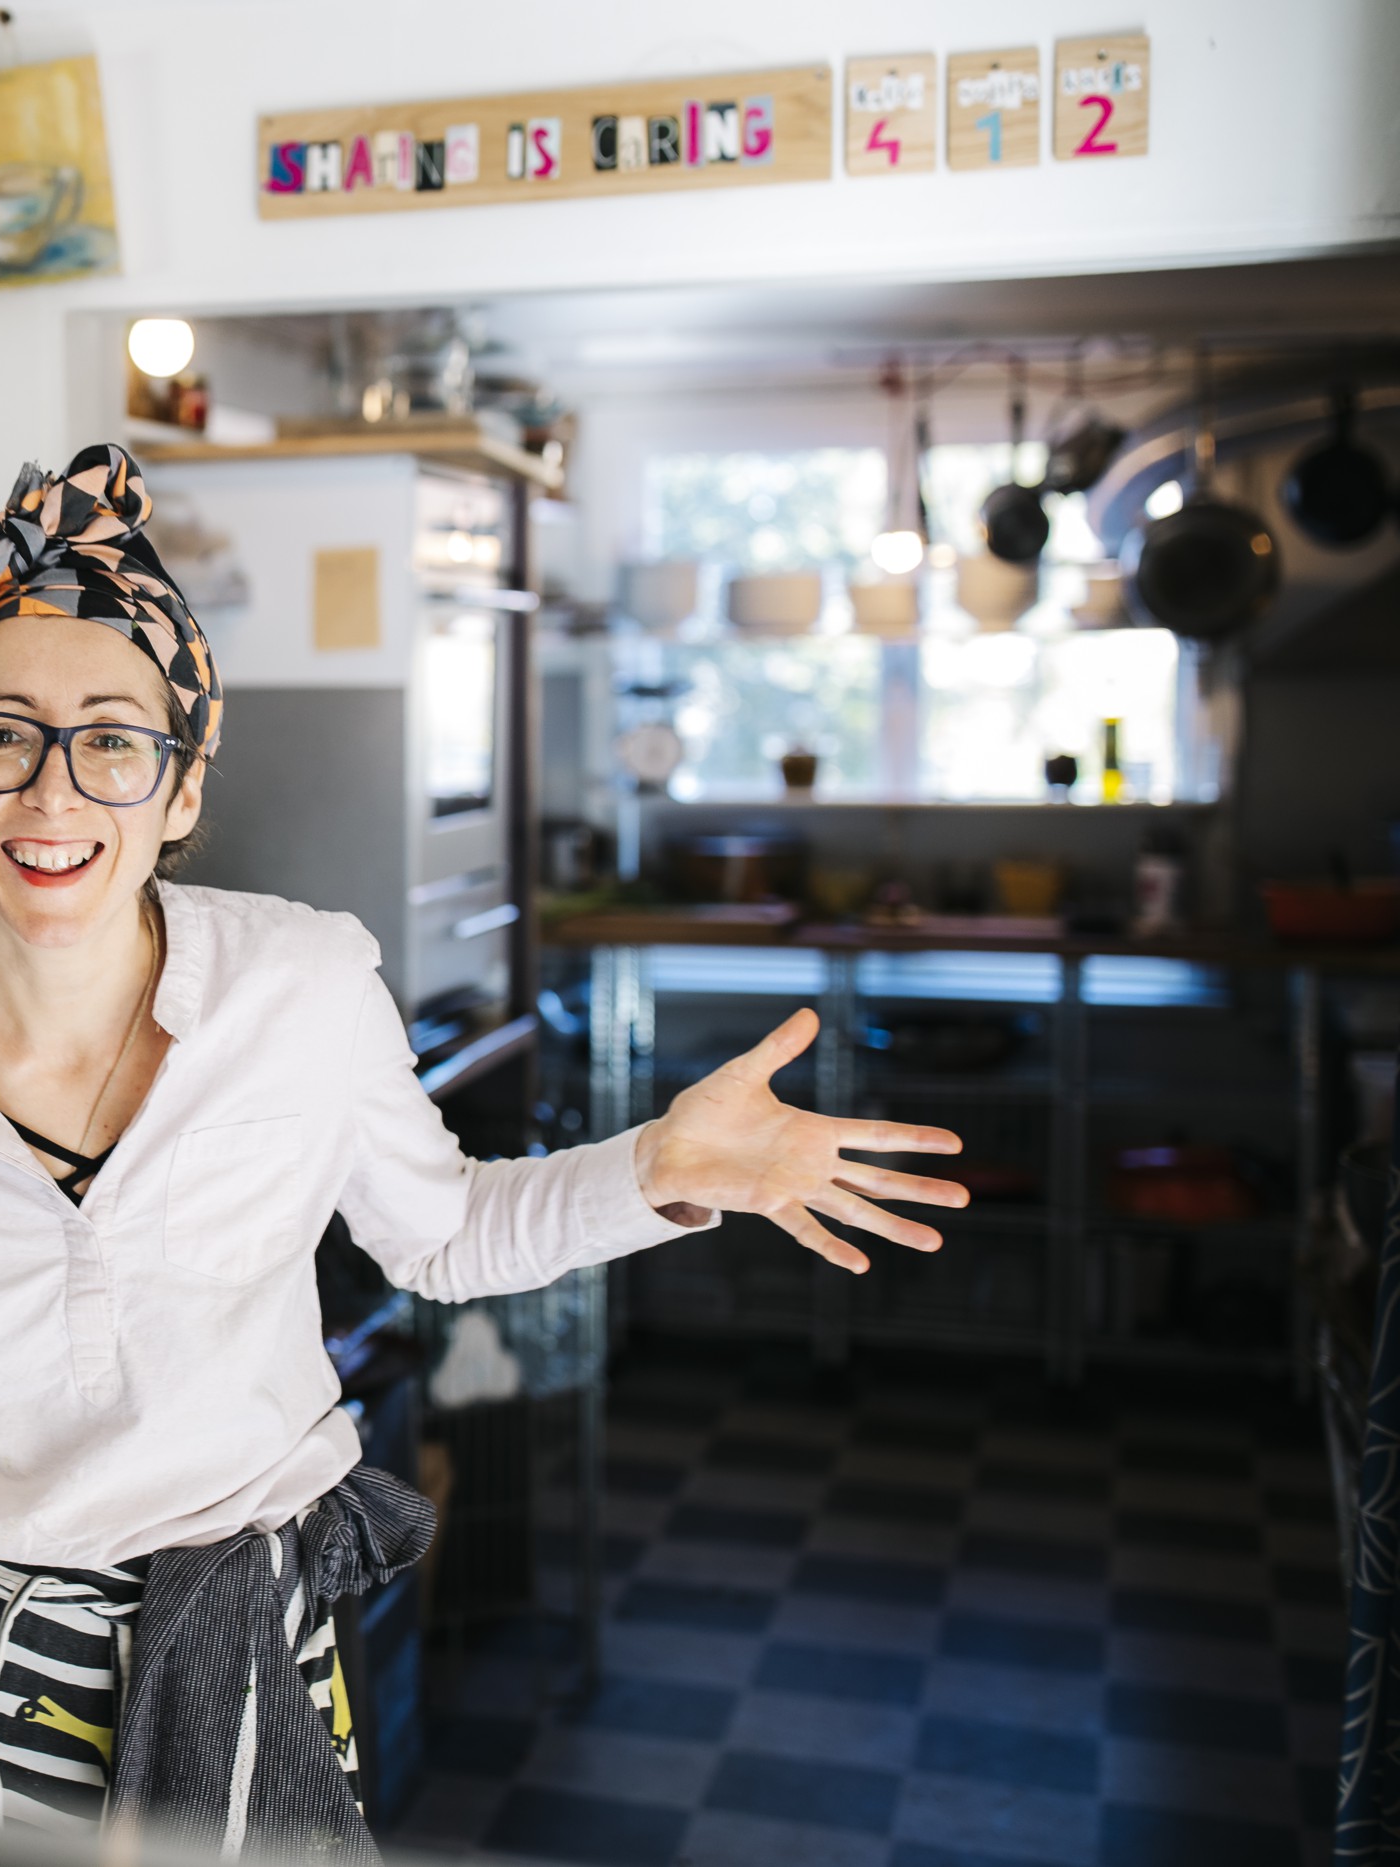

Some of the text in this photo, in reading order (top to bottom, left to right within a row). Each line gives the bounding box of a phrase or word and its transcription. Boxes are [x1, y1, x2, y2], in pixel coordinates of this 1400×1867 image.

[508, 124, 558, 180] IS
[865, 117, 902, 166] 4
[975, 111, 1002, 162] 1
[1074, 94, 1118, 158] 2
